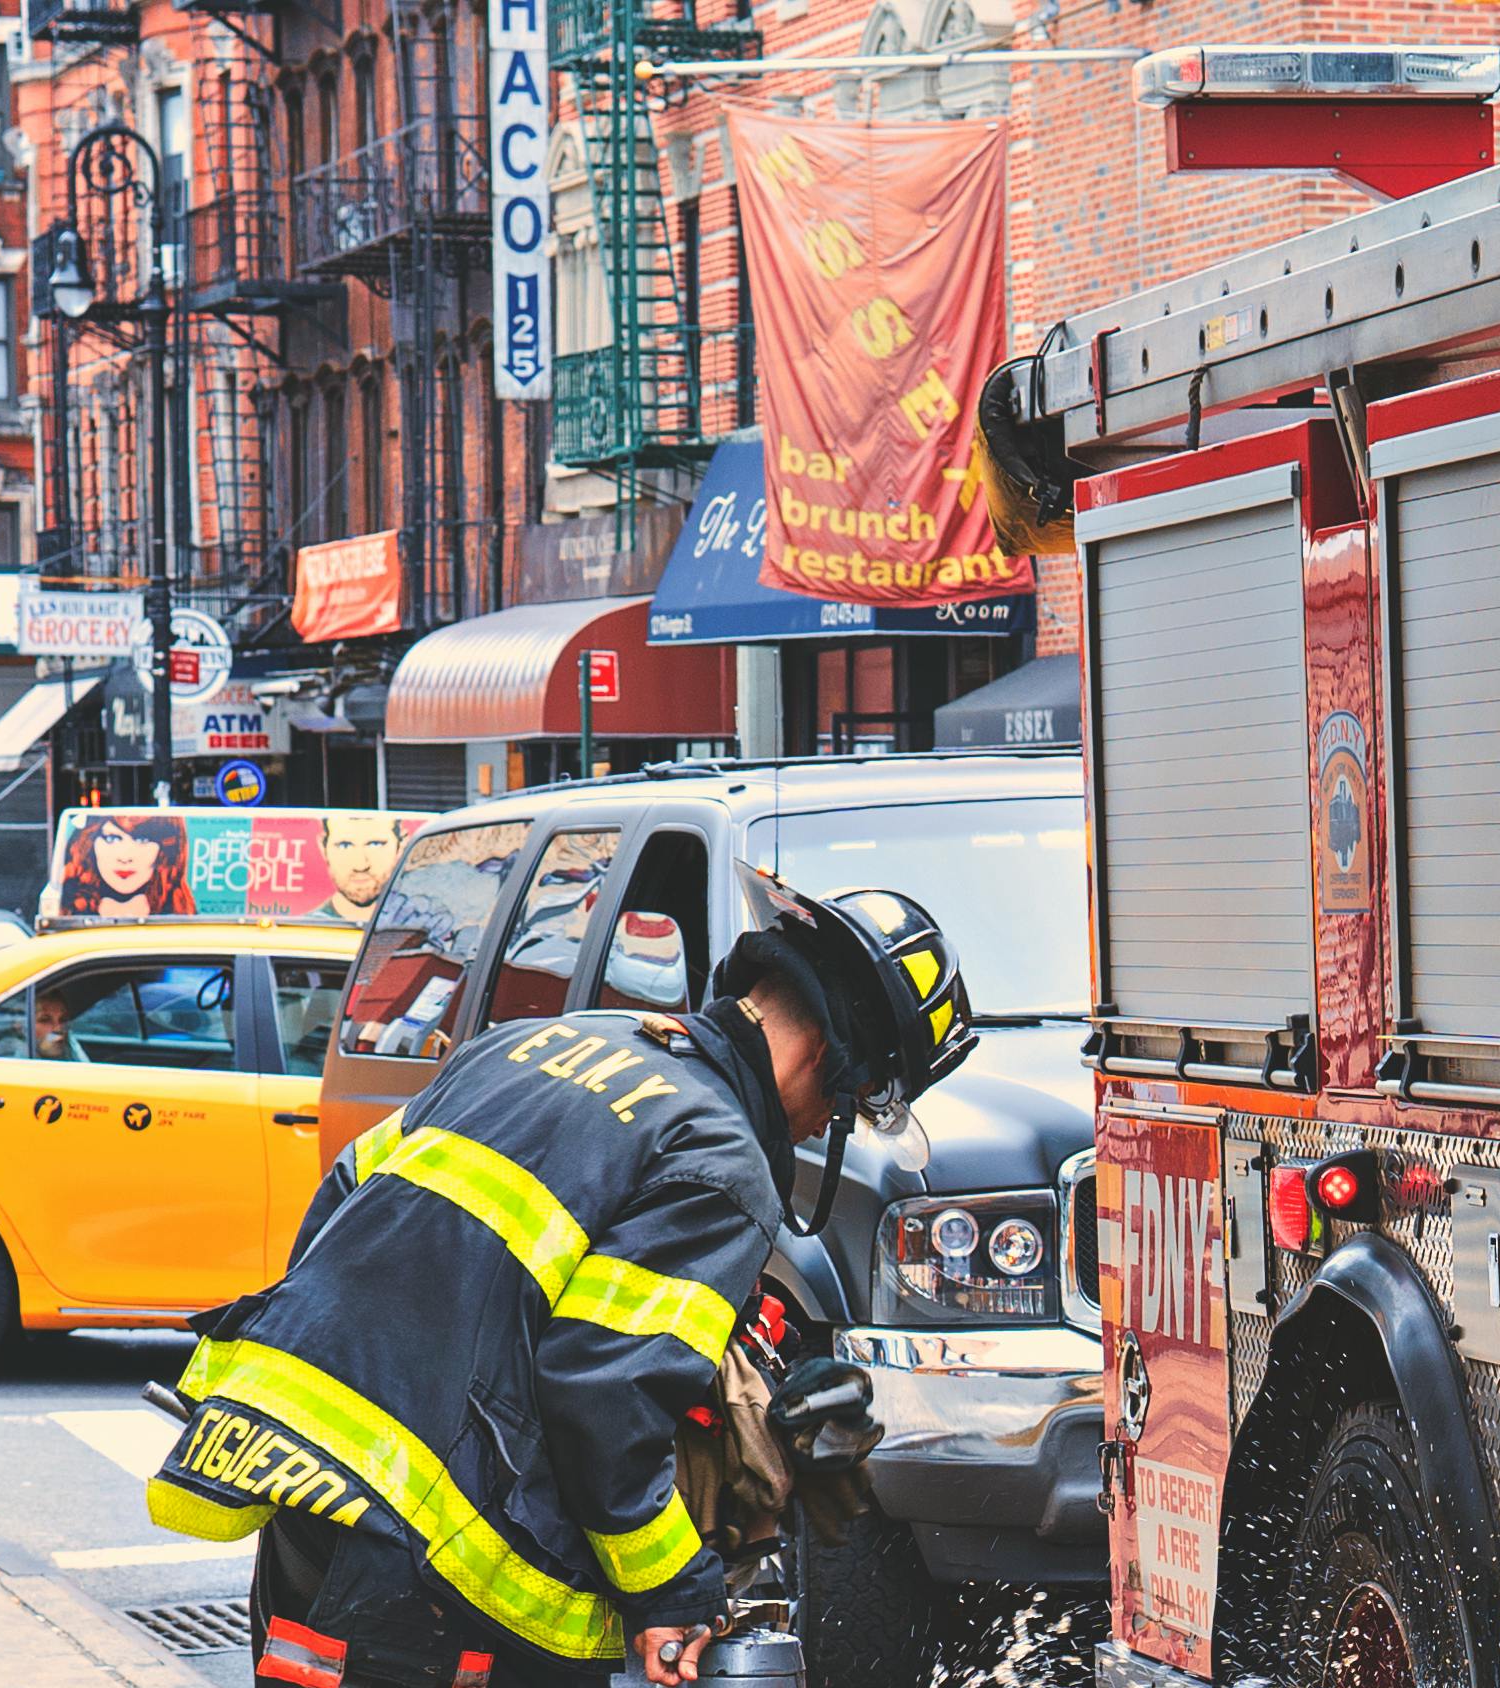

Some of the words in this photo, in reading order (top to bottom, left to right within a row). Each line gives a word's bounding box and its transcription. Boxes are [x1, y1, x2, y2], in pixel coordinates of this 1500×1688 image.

[512, 281, 538, 376] 125
[780, 435, 852, 483] bar
[694, 491, 737, 558] The
[781, 488, 938, 543] brunch
[781, 545, 1014, 590] restaurant
[28, 617, 132, 648] GROCERY
[936, 604, 1010, 625] Room
[203, 714, 262, 732] ATM
[208, 734, 270, 748] BEER
[1005, 710, 1054, 742] ESSEX
[193, 839, 306, 862] DIFFICULT
[192, 862, 304, 892] PEOPLE
[249, 902, 290, 915] hulu
[1123, 1168, 1211, 1346] FDNY
[1138, 1467, 1156, 1508] TO
[1159, 1472, 1213, 1525] REPORT
[1157, 1523, 1168, 1564] A
[1171, 1526, 1201, 1574] FIRE
[1150, 1571, 1185, 1619] DIAL
[1187, 1584, 1209, 1631] 911
